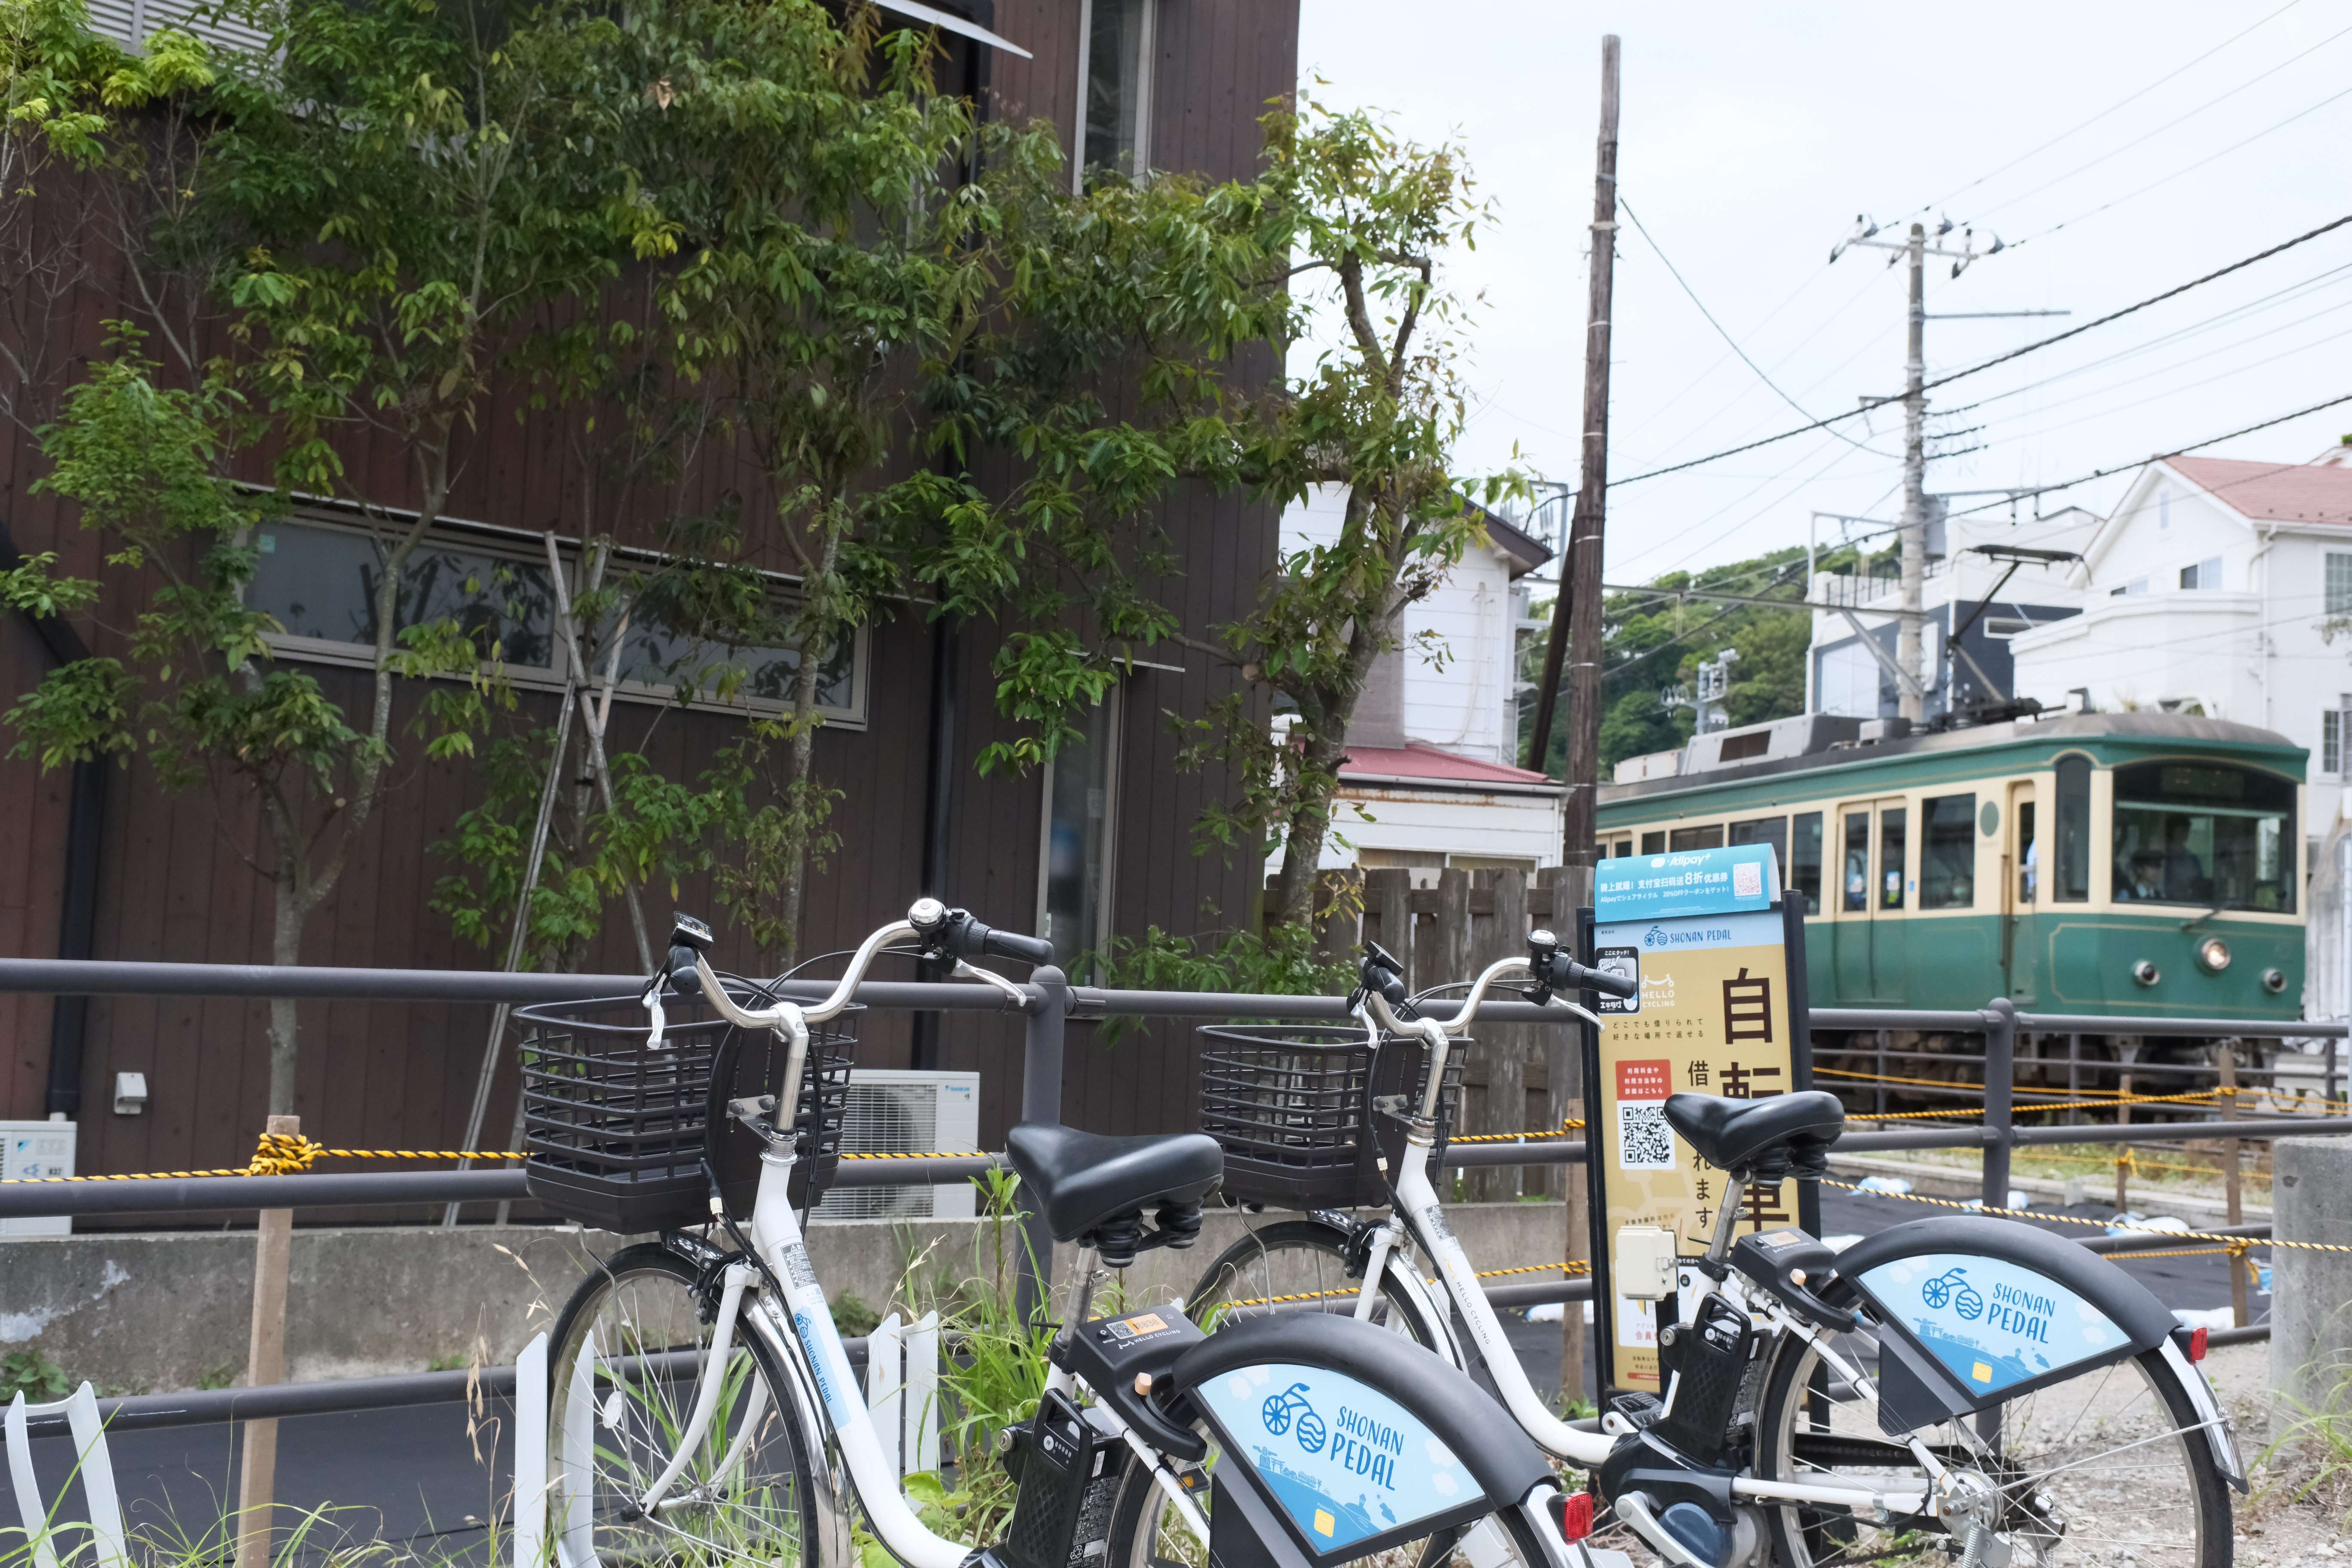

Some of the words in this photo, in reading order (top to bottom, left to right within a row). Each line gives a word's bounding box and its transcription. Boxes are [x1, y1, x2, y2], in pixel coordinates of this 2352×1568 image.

[1670, 931, 1703, 943] SHONAN
[1707, 929, 1731, 941] PEDAL
[1642, 990, 1675, 999] HELLO
[1613, 1018, 1703, 1029] どこでも借りられて
[1613, 1031, 1703, 1041] 好きな場所で返せる
[1688, 1060, 1713, 1228] 借れます
[1456, 1281, 1472, 1308] HELLO
[1471, 1310, 1491, 1344] CYCLING
[1993, 1283, 2055, 1317] SHONAN
[1135, 1335, 1154, 1343] HELLO
[1155, 1329, 1181, 1338] CYCLING
[1988, 1303, 2049, 1344] PEDAL
[805, 1340, 822, 1376] SHONAN
[819, 1377, 832, 1405] PEDAL
[1336, 1406, 1404, 1456] SHONAN
[1330, 1432, 1396, 1491] PEDAL
